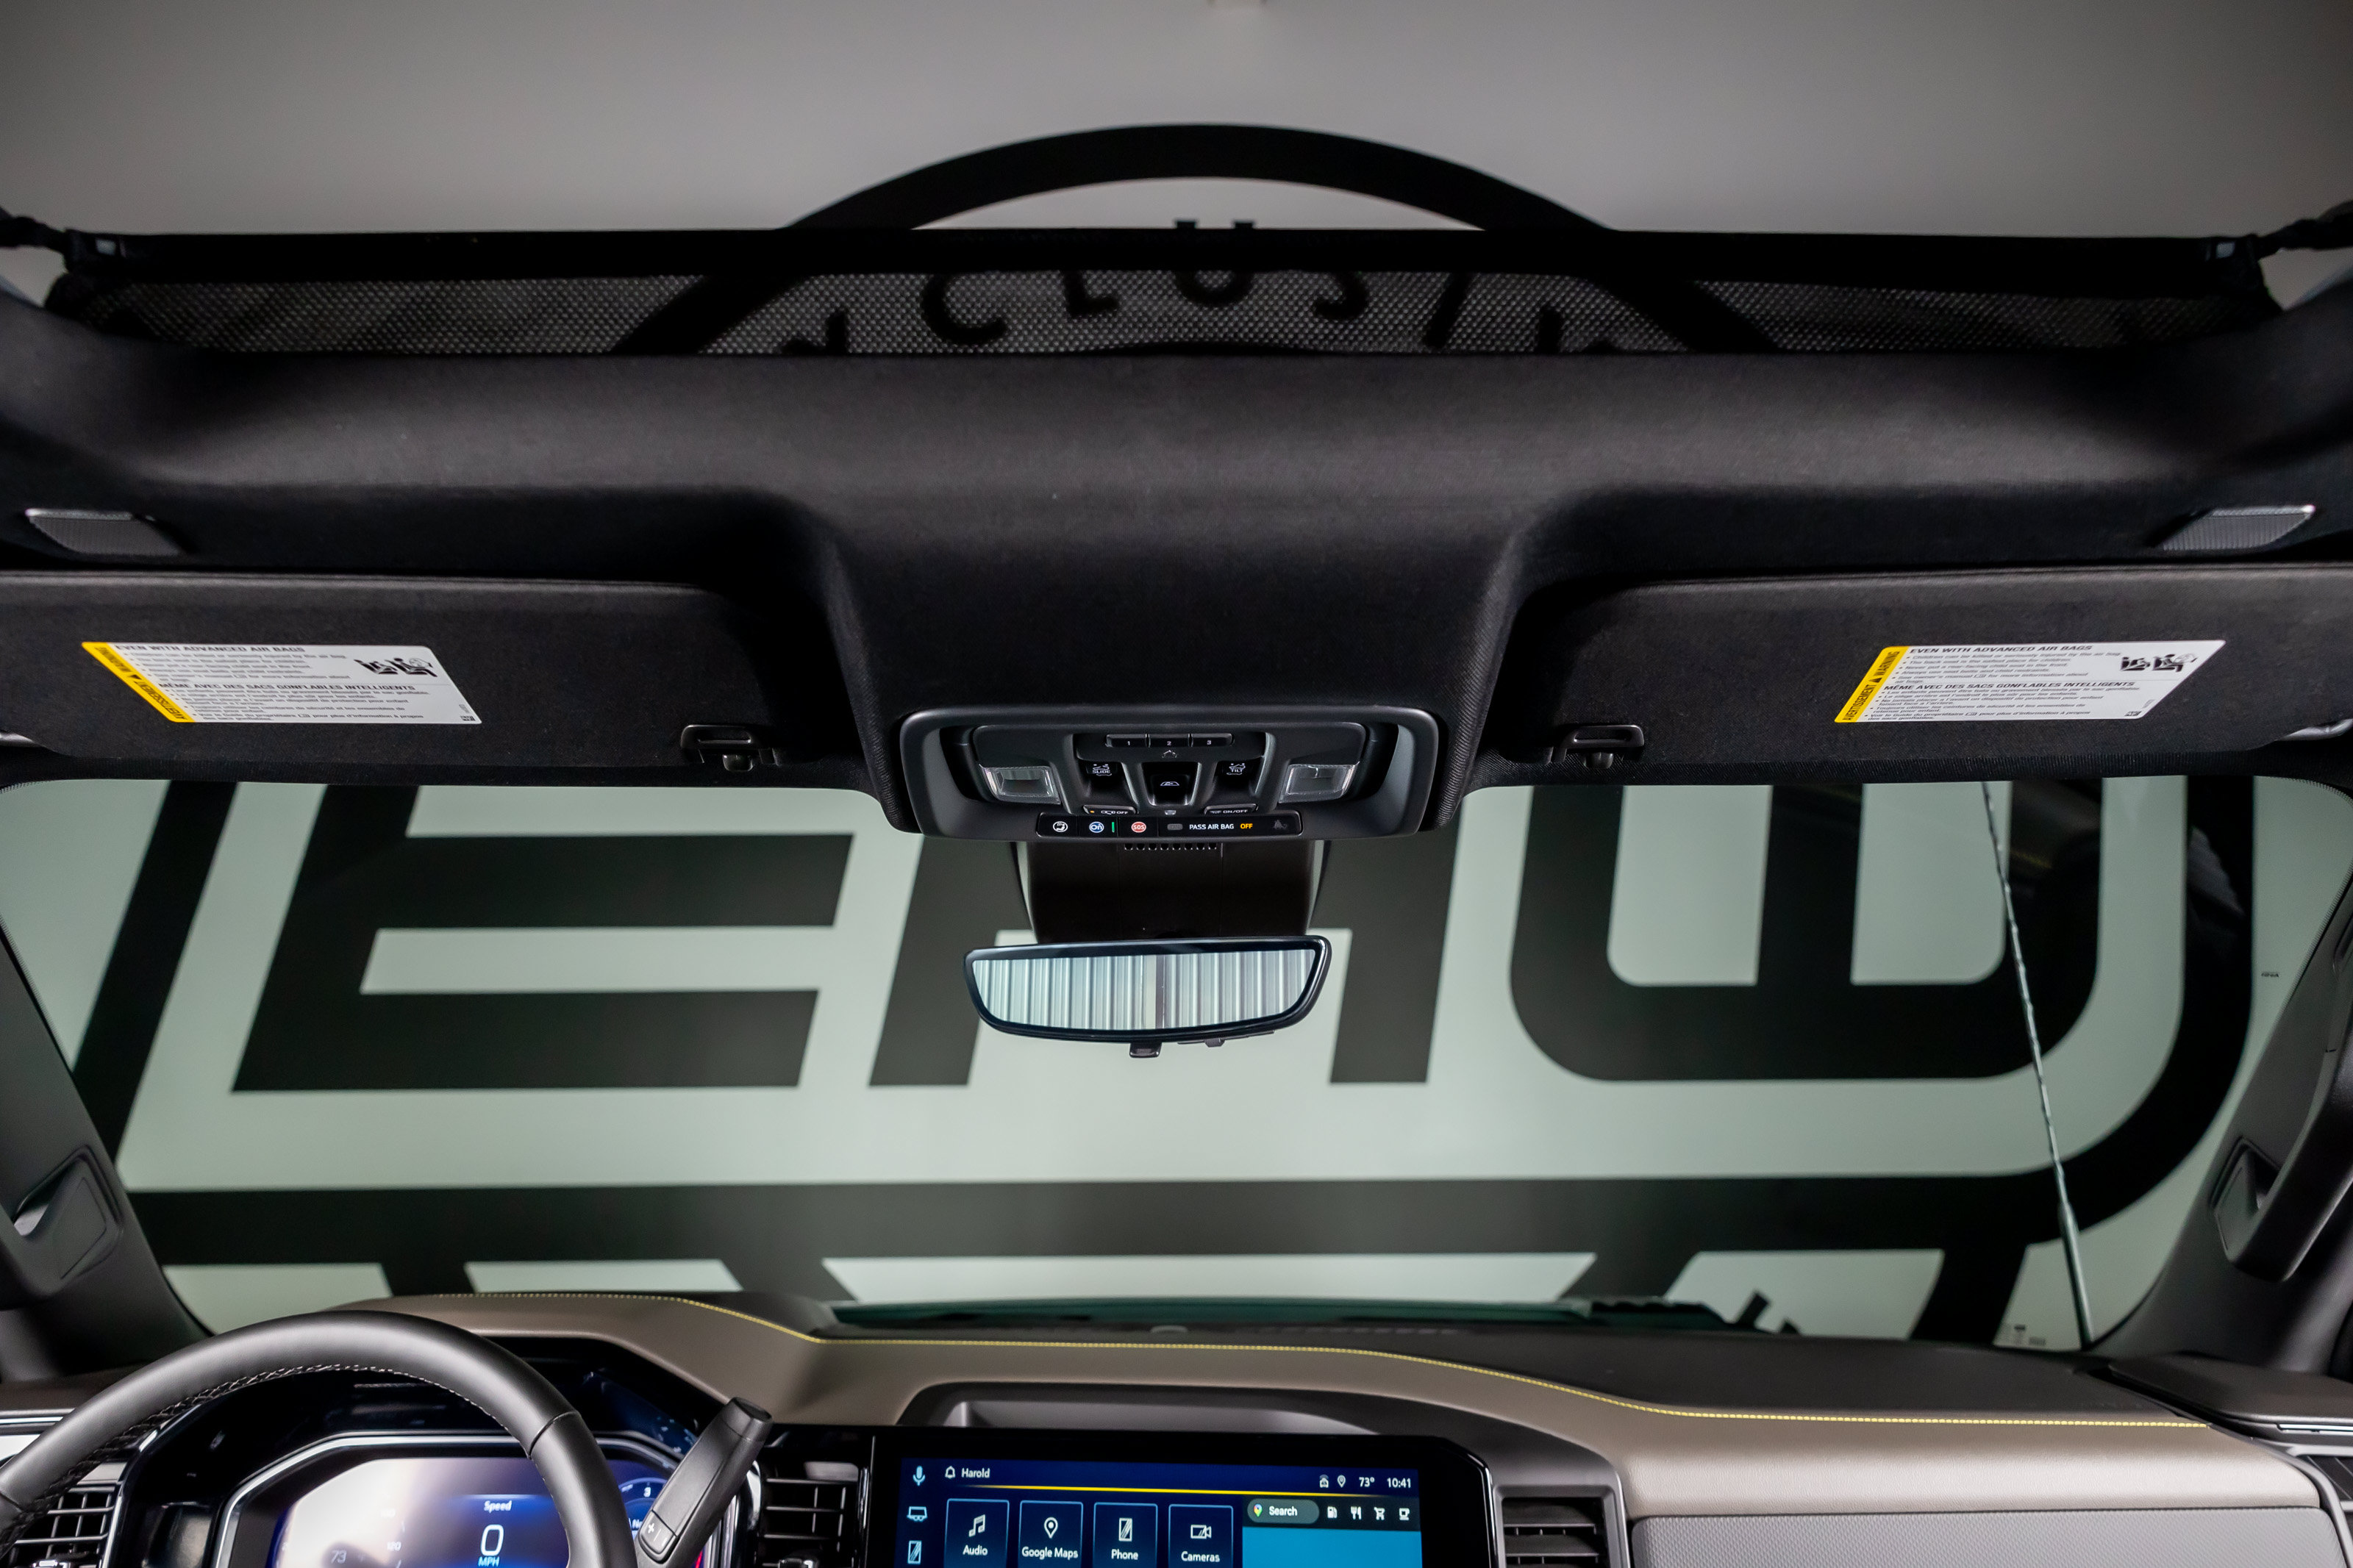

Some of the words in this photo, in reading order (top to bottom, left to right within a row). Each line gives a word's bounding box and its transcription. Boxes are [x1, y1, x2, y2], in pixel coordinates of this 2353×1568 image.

[1873, 651, 1900, 676] WARNING
[1842, 684, 1877, 720] AVERTISSEMENT
[961, 1468, 990, 1478] Harold
[1386, 1478, 1411, 1488] 10:41
[484, 1500, 512, 1513] Speed
[1269, 1506, 1298, 1516] Search
[481, 1524, 504, 1556] 0
[963, 1545, 988, 1556] Audio
[1022, 1546, 1053, 1560] Google
[1054, 1547, 1078, 1560] Maps
[1112, 1549, 1138, 1560] Phone
[1181, 1551, 1220, 1562] Cameras
[330, 1550, 347, 1564] 73
[477, 1556, 500, 1568] MPH
